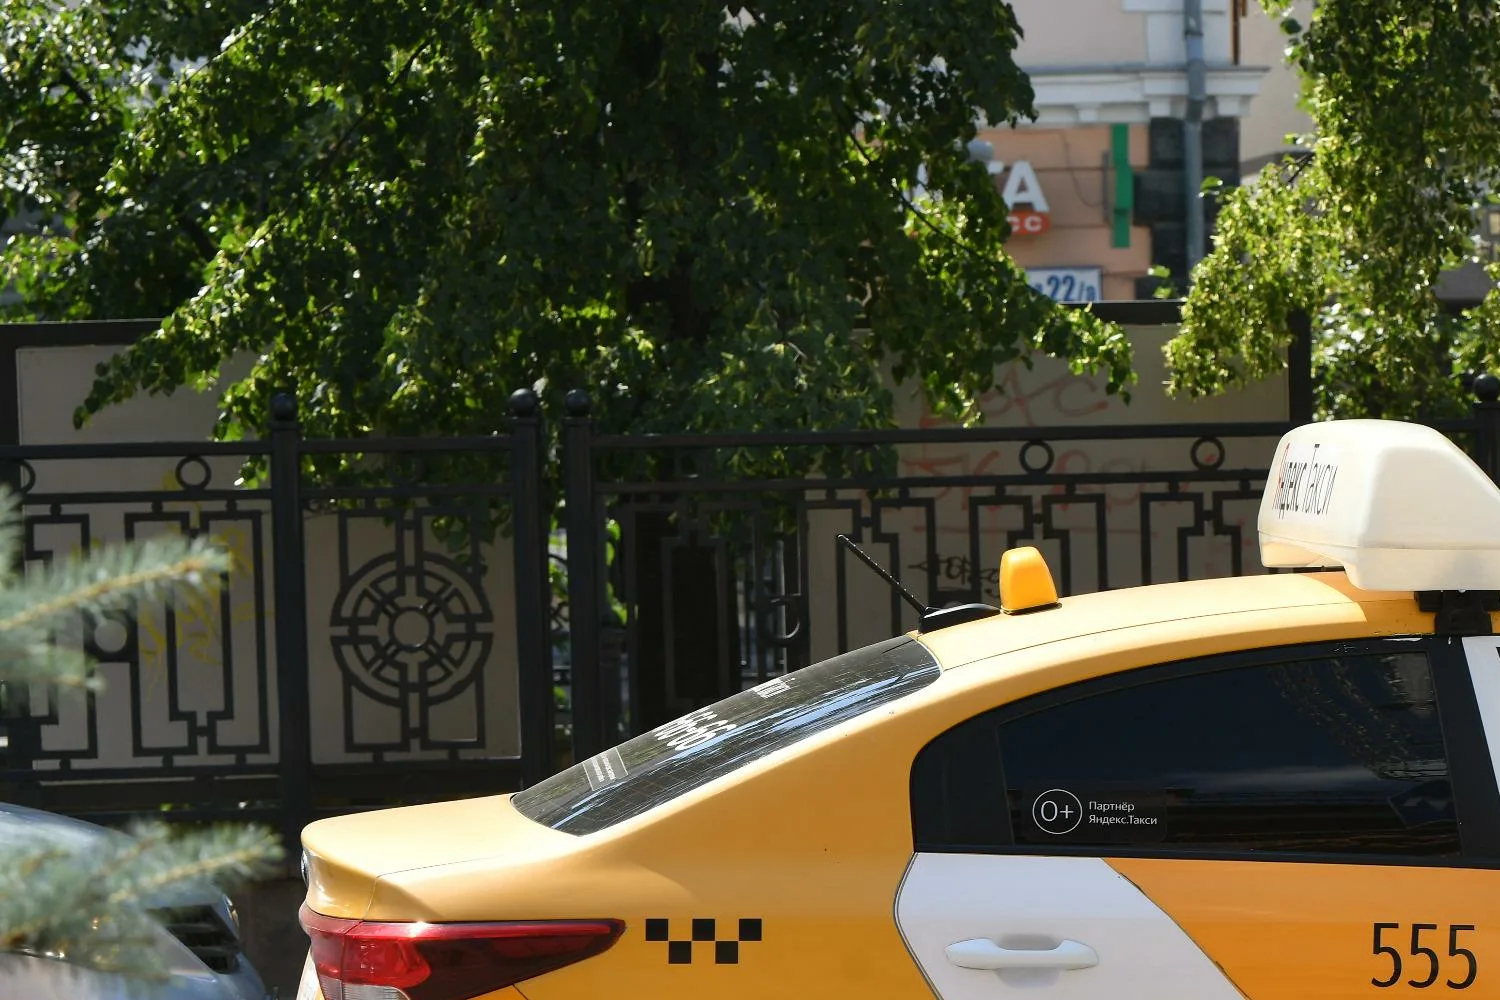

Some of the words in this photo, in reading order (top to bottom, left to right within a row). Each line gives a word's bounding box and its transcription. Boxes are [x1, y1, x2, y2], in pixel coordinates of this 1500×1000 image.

[1088, 801, 1135, 812] Партнёр
[1088, 814, 1158, 825] Яндекс.Такси
[1371, 922, 1478, 990] 555
